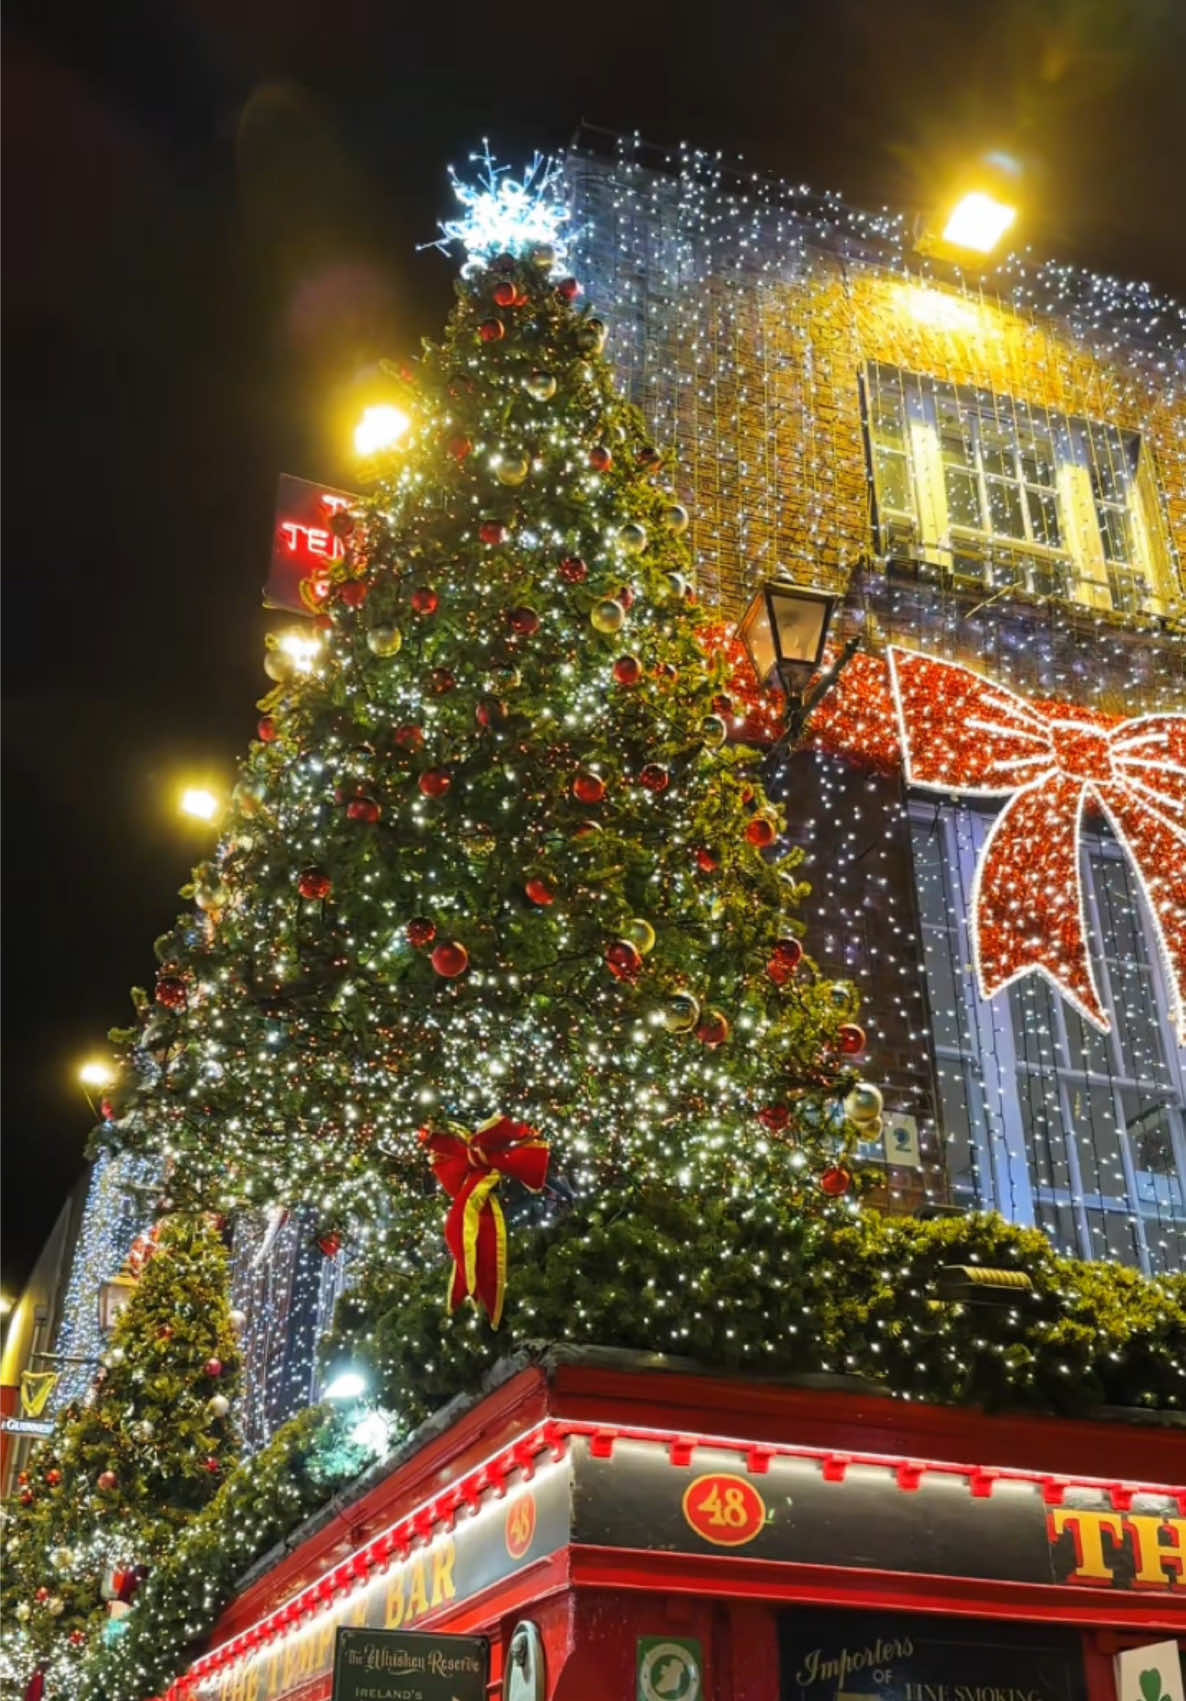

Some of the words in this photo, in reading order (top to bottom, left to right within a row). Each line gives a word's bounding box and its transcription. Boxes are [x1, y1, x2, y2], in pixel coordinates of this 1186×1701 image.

[696, 1483, 748, 1527] 48
[385, 1543, 456, 1628] BAR
[427, 1649, 480, 1678] Reserve
[796, 1637, 914, 1689] Importers
[872, 1669, 894, 1683] OF
